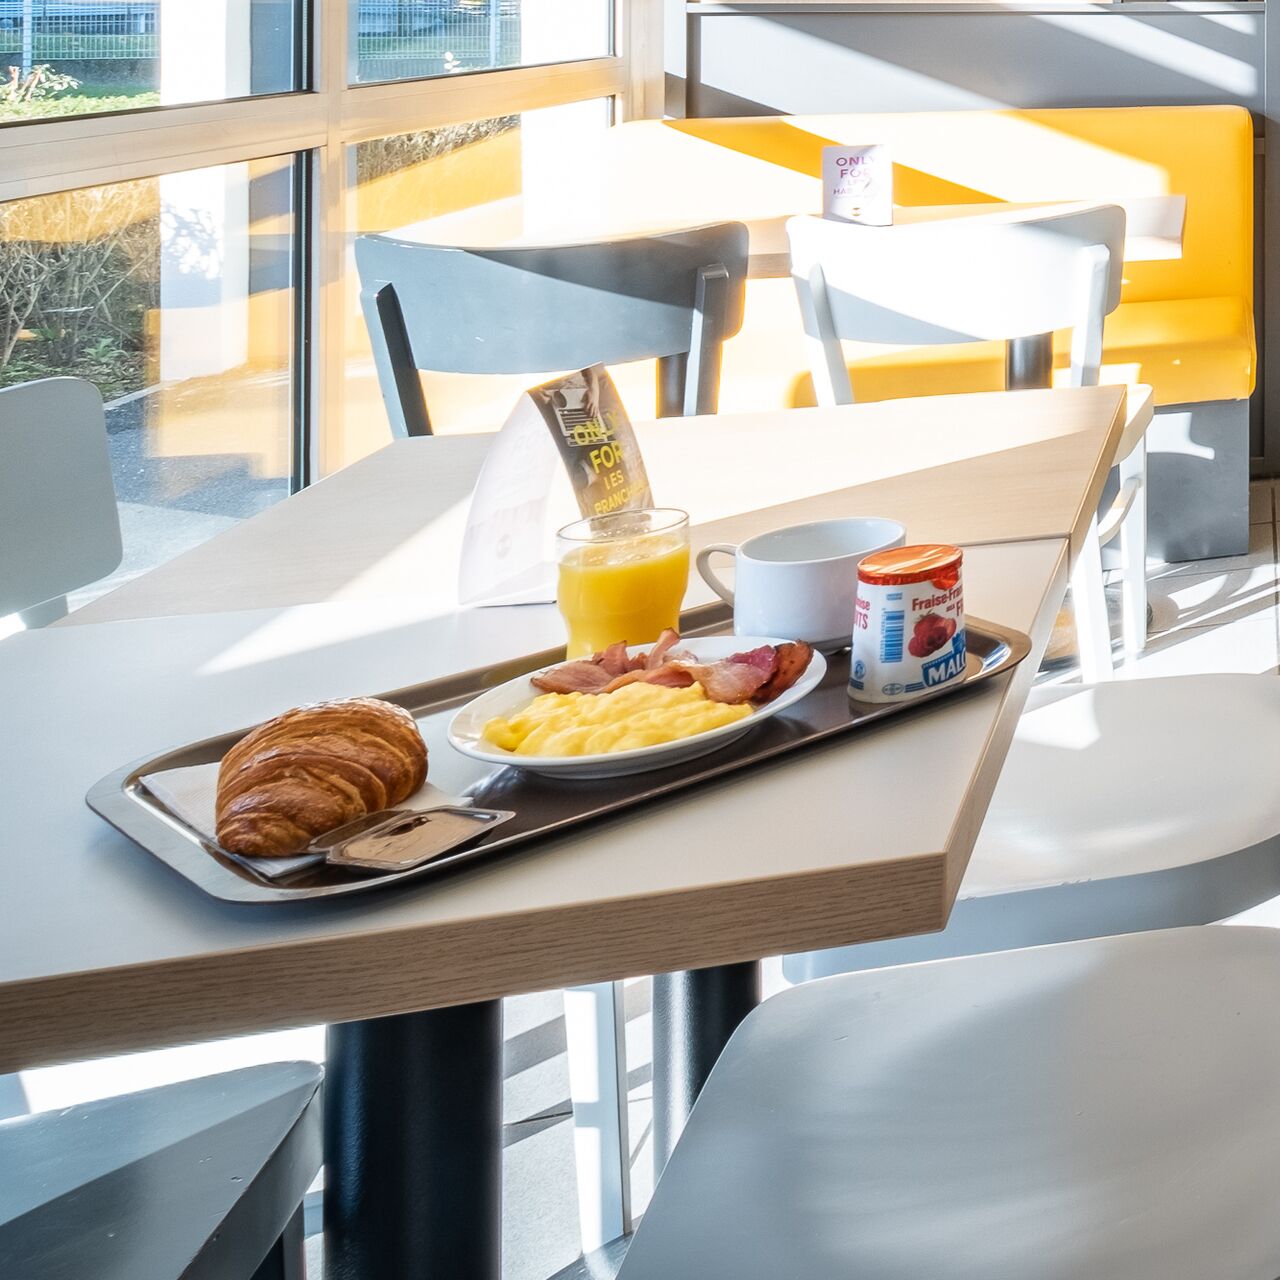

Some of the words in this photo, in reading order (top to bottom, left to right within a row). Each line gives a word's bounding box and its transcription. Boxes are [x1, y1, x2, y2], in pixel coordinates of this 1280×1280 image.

[836, 156, 874, 167] ONLY
[574, 412, 620, 446] ONLY
[590, 441, 624, 474] FOR
